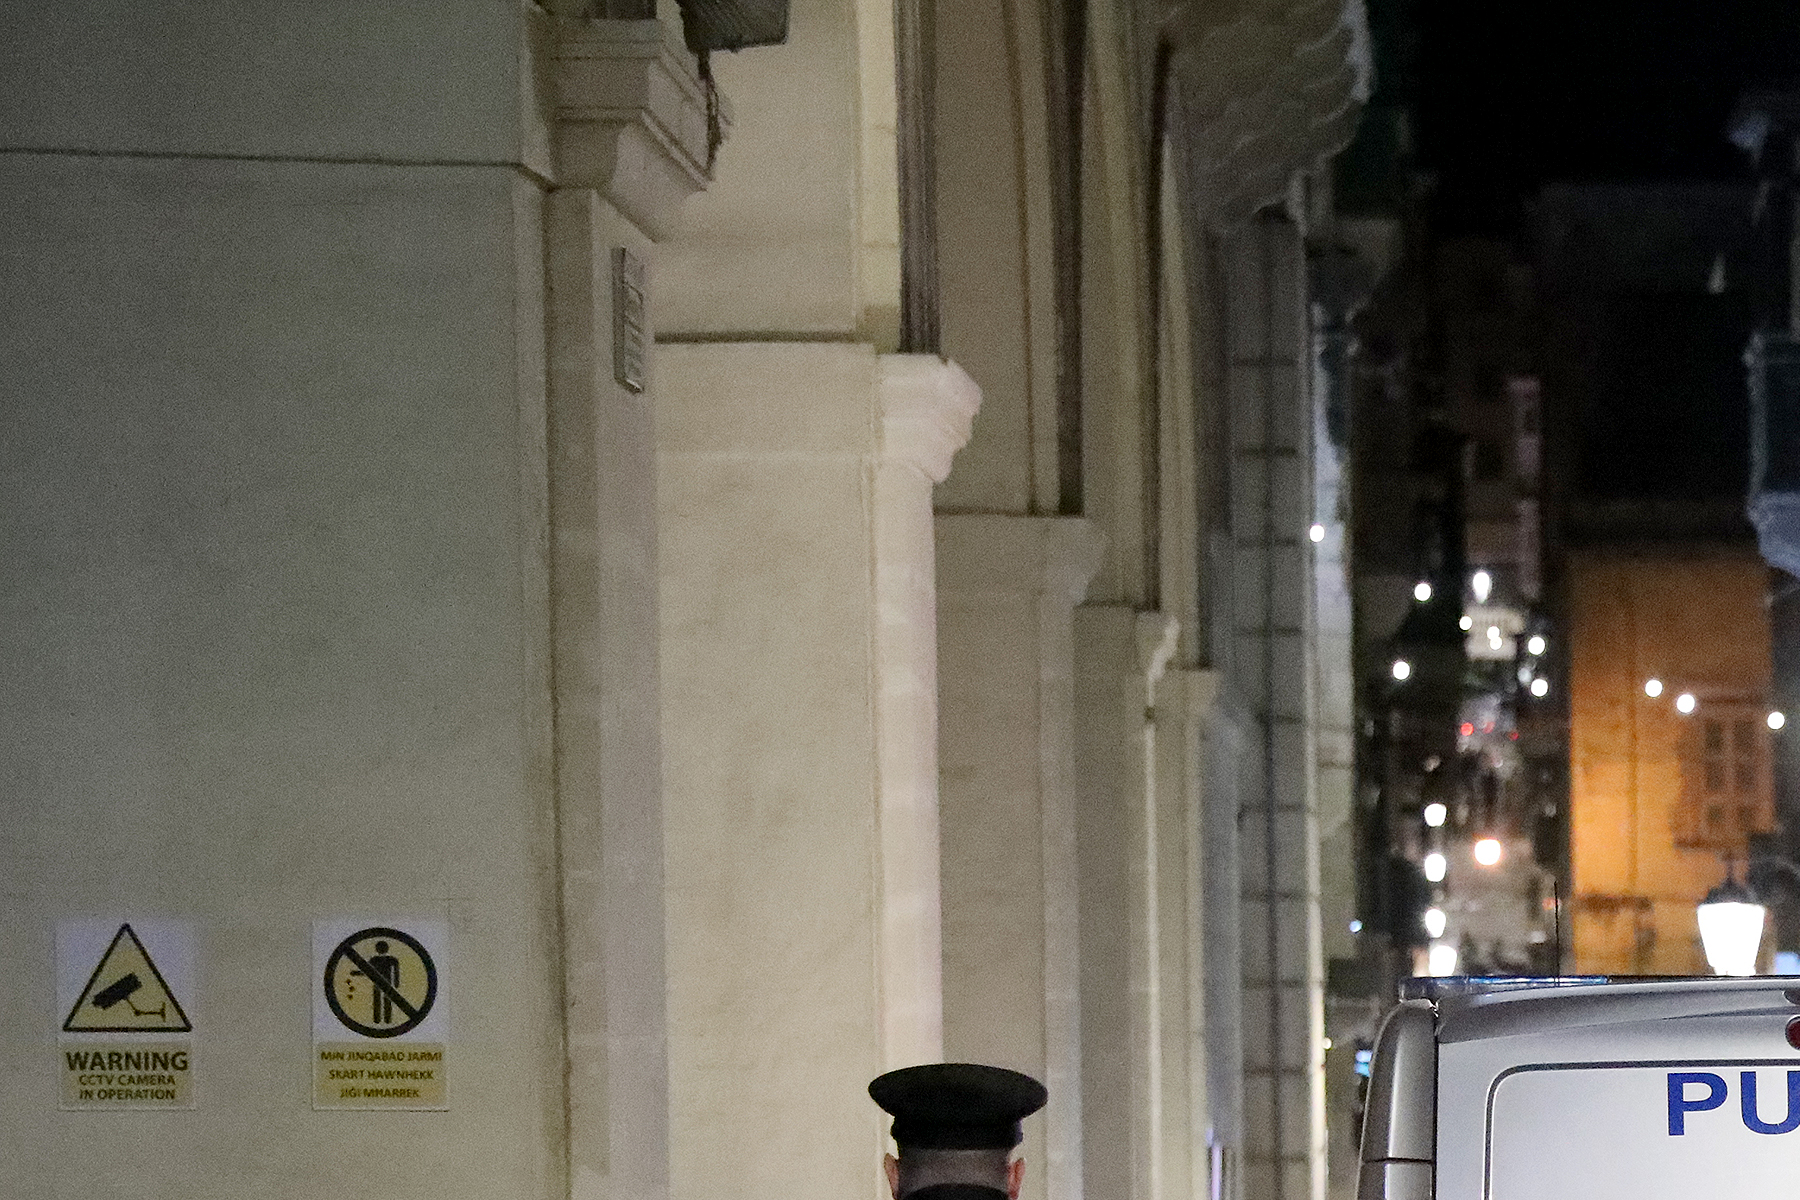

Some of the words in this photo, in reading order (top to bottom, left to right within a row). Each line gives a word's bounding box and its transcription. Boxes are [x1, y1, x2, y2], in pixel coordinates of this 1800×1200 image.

[66, 1051, 188, 1071] WARNING
[320, 1051, 344, 1061] MIN
[78, 1074, 114, 1086] CCTV
[117, 1074, 176, 1086] CAMERA
[329, 1069, 364, 1080] SKART
[79, 1089, 94, 1100] IN
[97, 1088, 176, 1100] OPERATION
